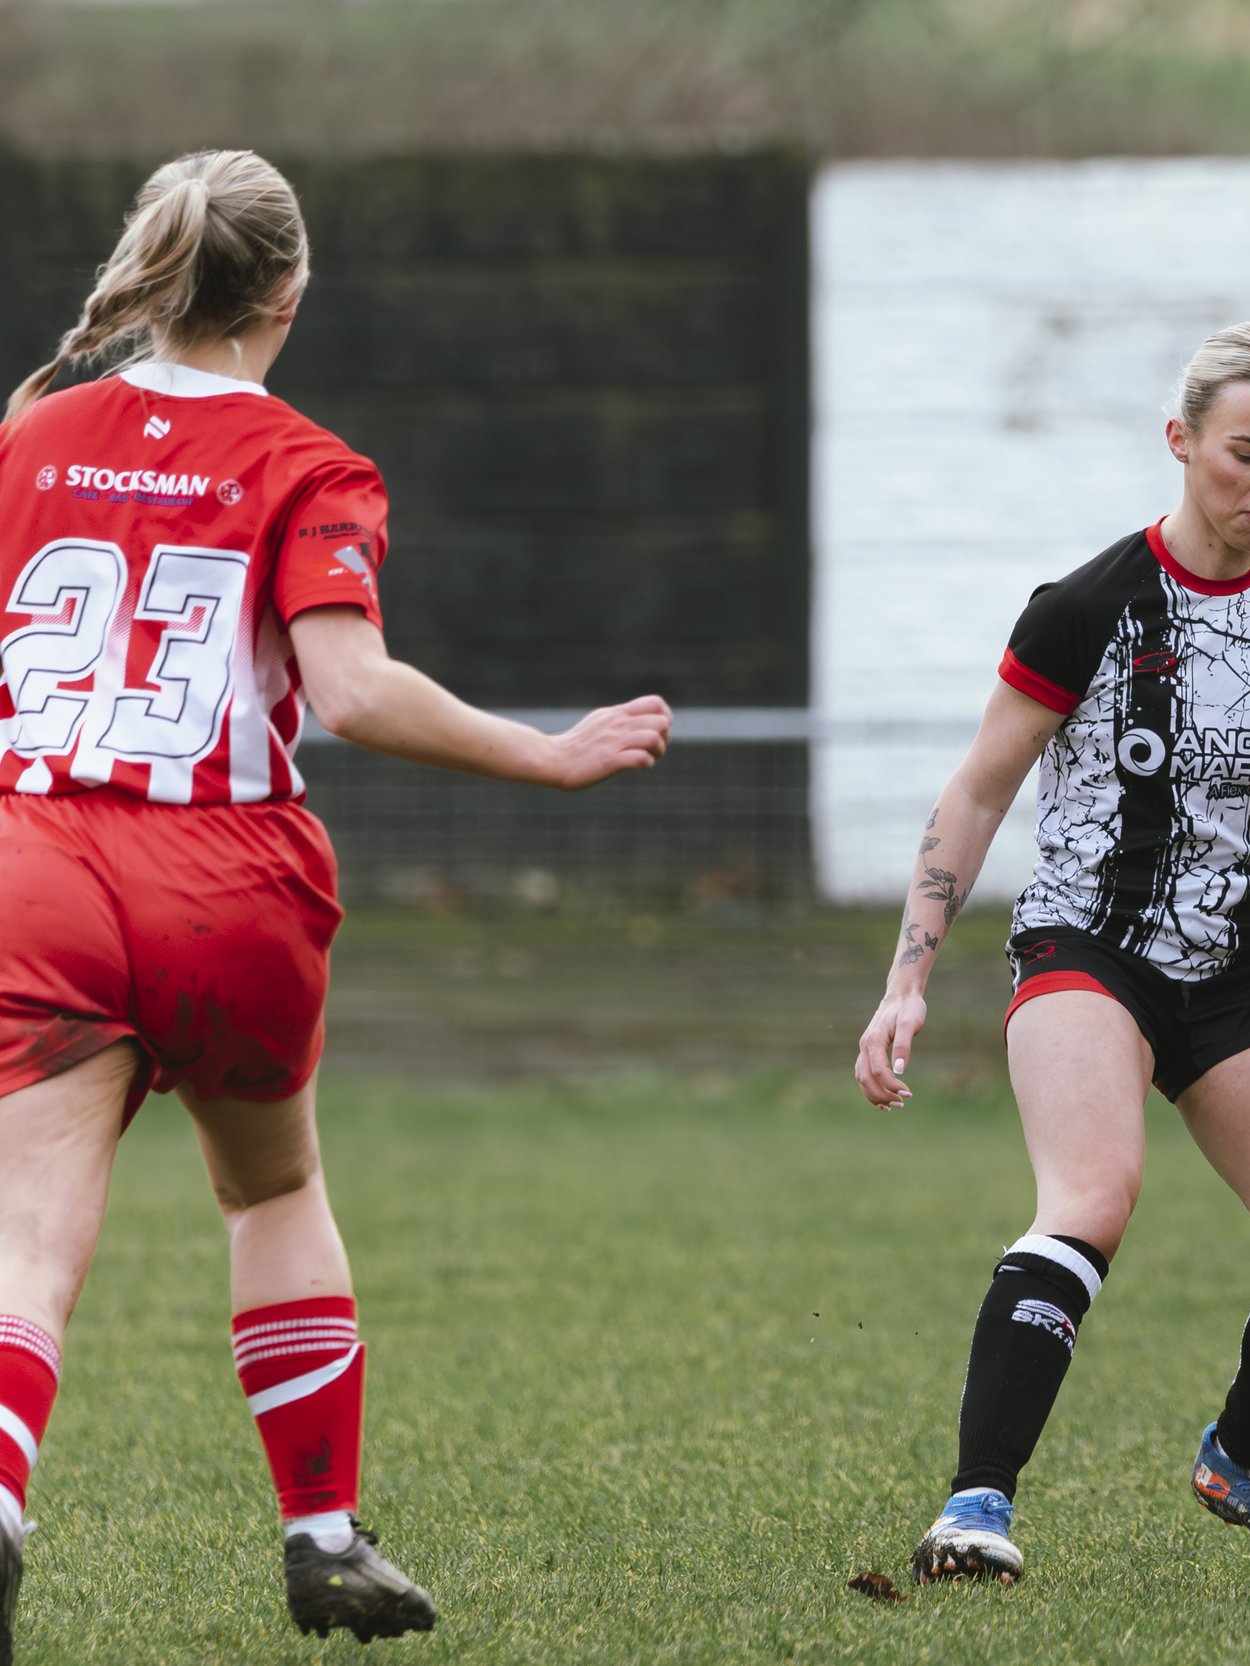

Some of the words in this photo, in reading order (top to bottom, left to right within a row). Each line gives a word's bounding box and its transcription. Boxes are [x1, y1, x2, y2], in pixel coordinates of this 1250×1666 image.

[65, 464, 211, 497] STOCKSMAN
[0, 538, 250, 764] 23
[1210, 787, 1218, 798] A
[1221, 785, 1242, 796] Flex
